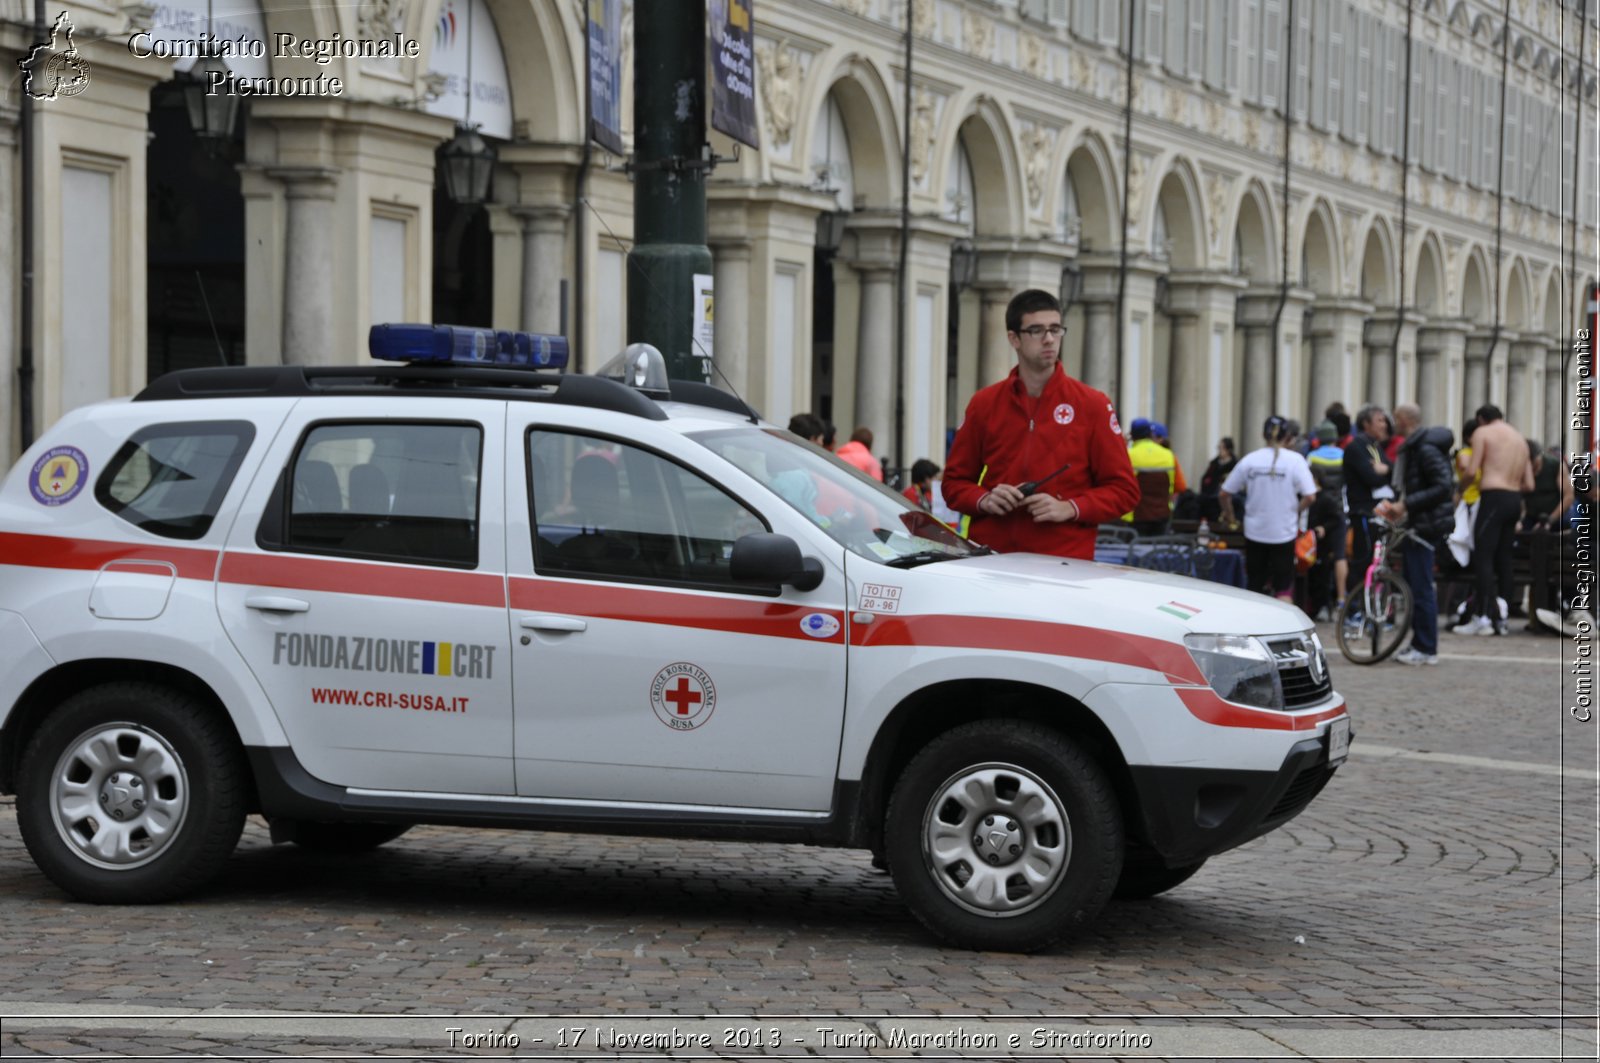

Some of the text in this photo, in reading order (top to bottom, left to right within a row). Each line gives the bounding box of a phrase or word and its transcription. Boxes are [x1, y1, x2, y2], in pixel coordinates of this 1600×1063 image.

[867, 586, 897, 598] TO 10
[864, 599, 875, 609] 20
[882, 600, 893, 610] 96
[273, 632, 496, 680] FONDAZIONE CRT
[653, 664, 714, 709] CROCE ROSSA ITALIANA
[312, 688, 469, 713] WWW.CRI-SUSA.IT
[670, 718, 694, 729] SUSA
